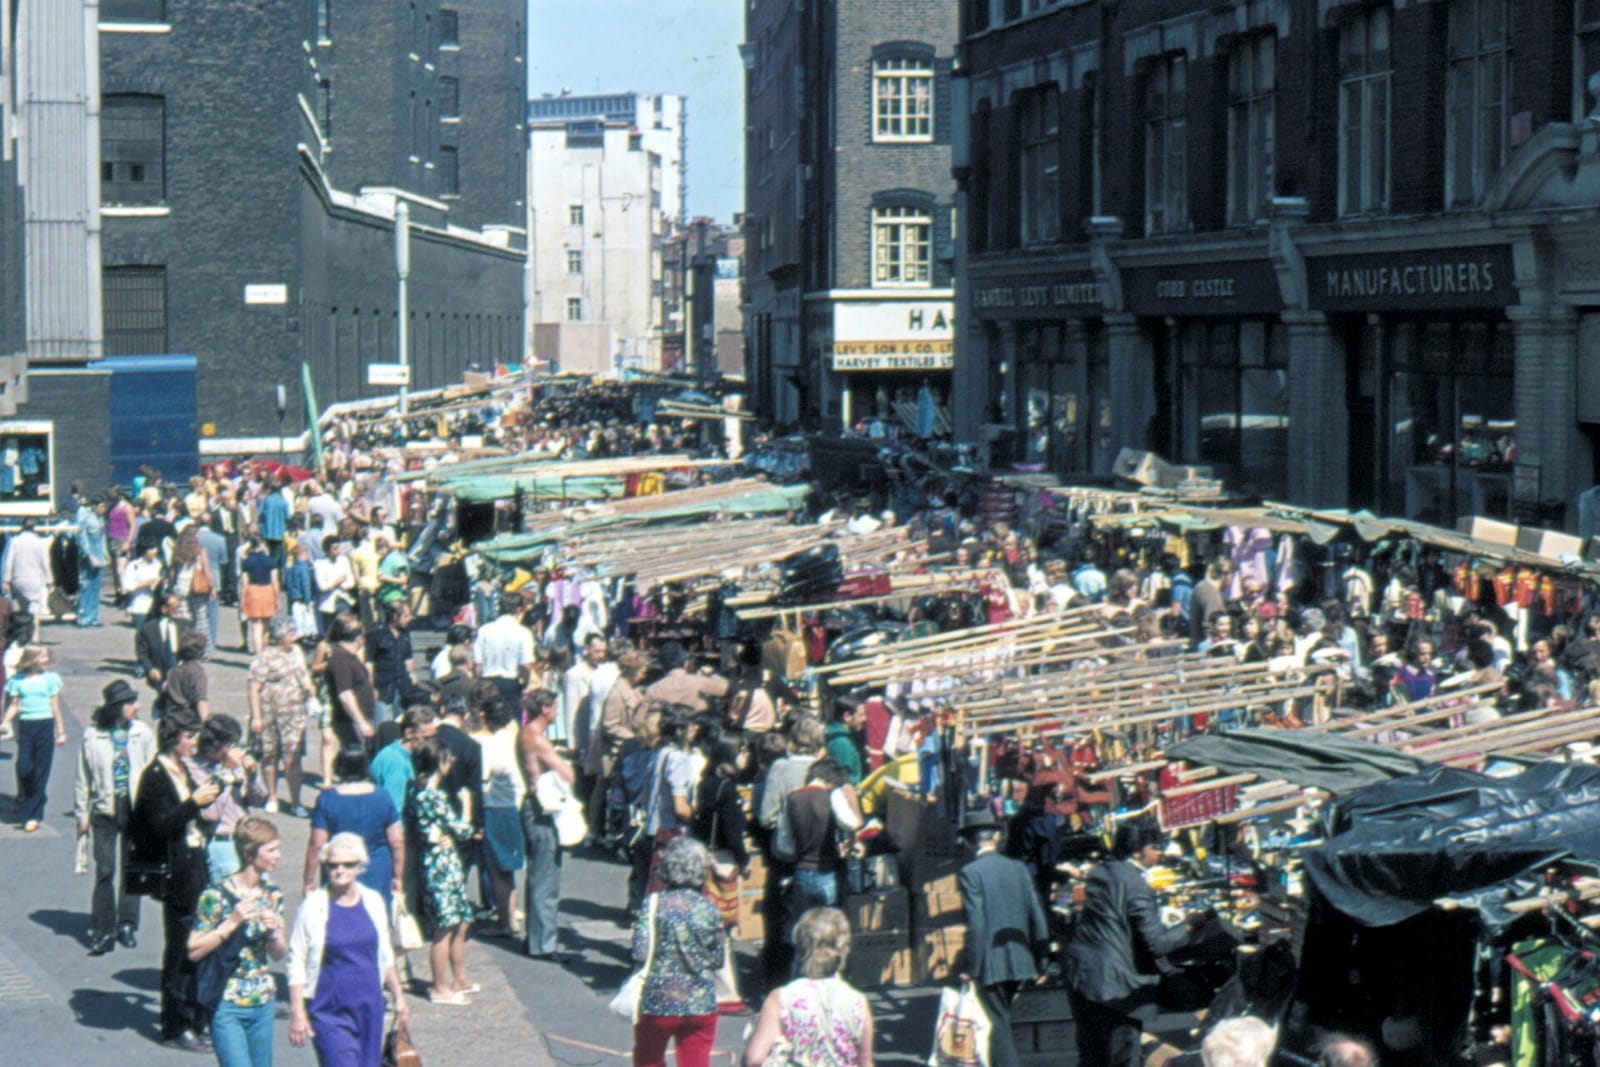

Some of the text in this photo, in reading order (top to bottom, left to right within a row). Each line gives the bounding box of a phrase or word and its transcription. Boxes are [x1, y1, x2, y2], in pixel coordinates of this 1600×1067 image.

[1192, 278, 1234, 296] CASTLE
[1327, 263, 1493, 296] MANUFACTURERS
[908, 308, 951, 331] HA
[874, 343, 897, 354] SON
[903, 343, 910, 353] &
[837, 357, 879, 368] HARVEY
[887, 356, 935, 367] TEXTILES
